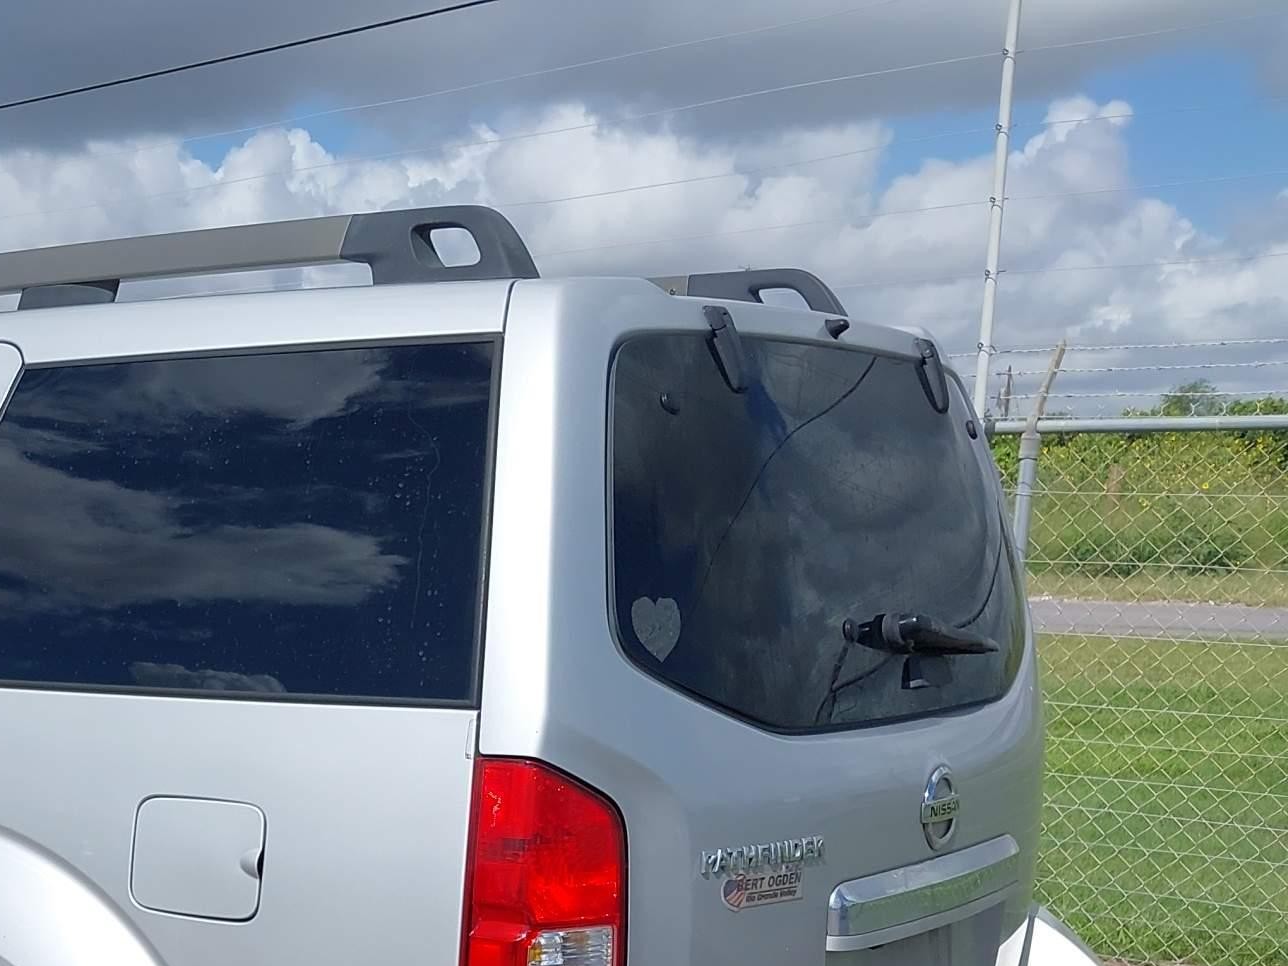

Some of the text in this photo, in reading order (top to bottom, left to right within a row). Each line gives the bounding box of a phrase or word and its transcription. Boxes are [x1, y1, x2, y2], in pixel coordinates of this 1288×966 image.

[930, 799, 961, 818] NISSAN
[701, 836, 824, 873] PATHFINDER
[737, 871, 802, 892] BERT OGDEN
